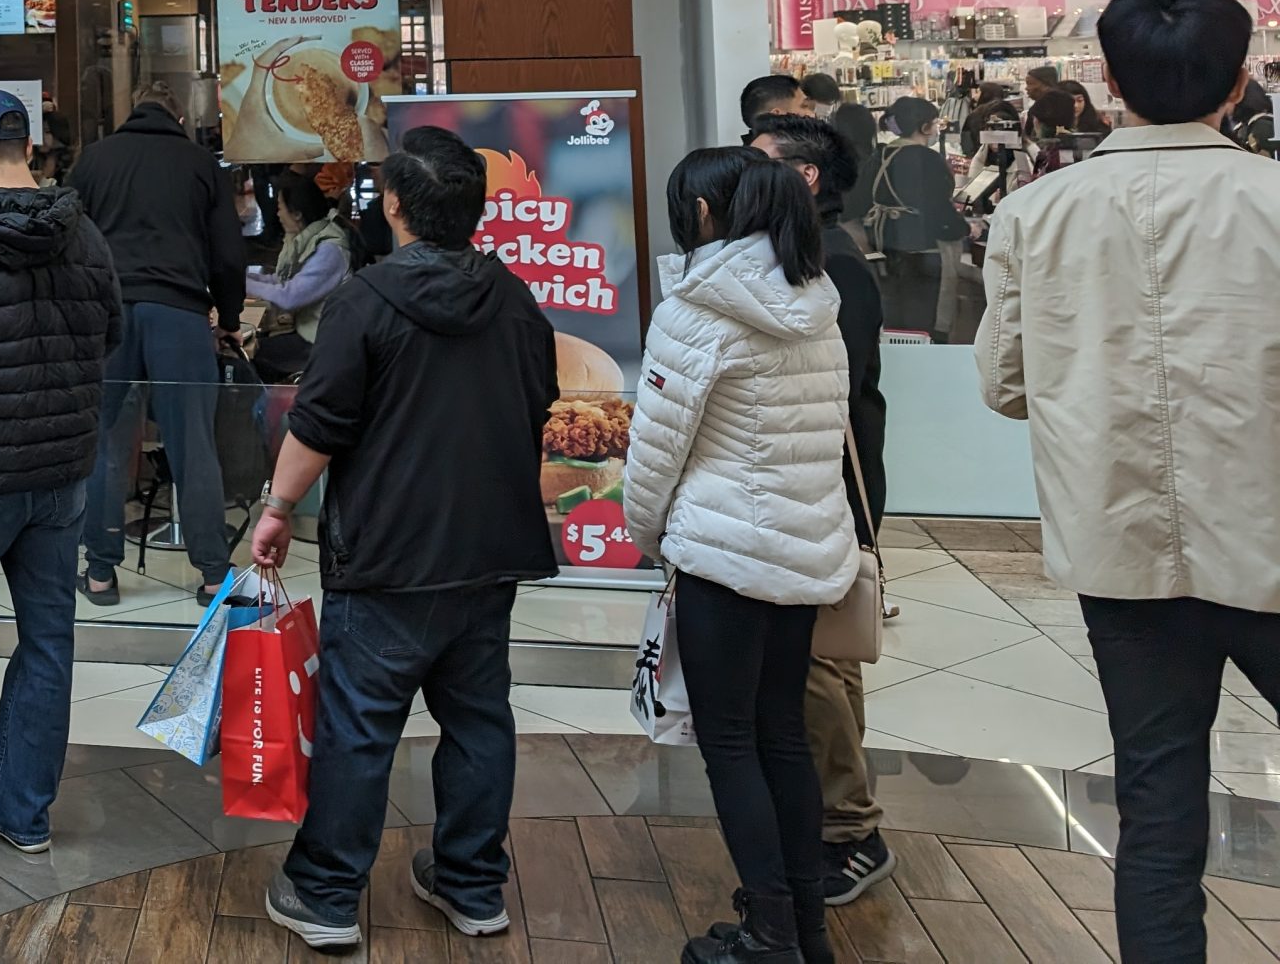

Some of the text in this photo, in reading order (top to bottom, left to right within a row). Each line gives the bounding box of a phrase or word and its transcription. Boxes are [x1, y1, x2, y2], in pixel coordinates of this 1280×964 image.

[268, 15, 348, 25] NEW & IMPROVED!
[351, 47, 373, 55] SERVED
[566, 134, 611, 146] Jollibee
[476, 191, 568, 232] picy
[474, 234, 601, 271] icken
[252, 717, 263, 750] FOR
